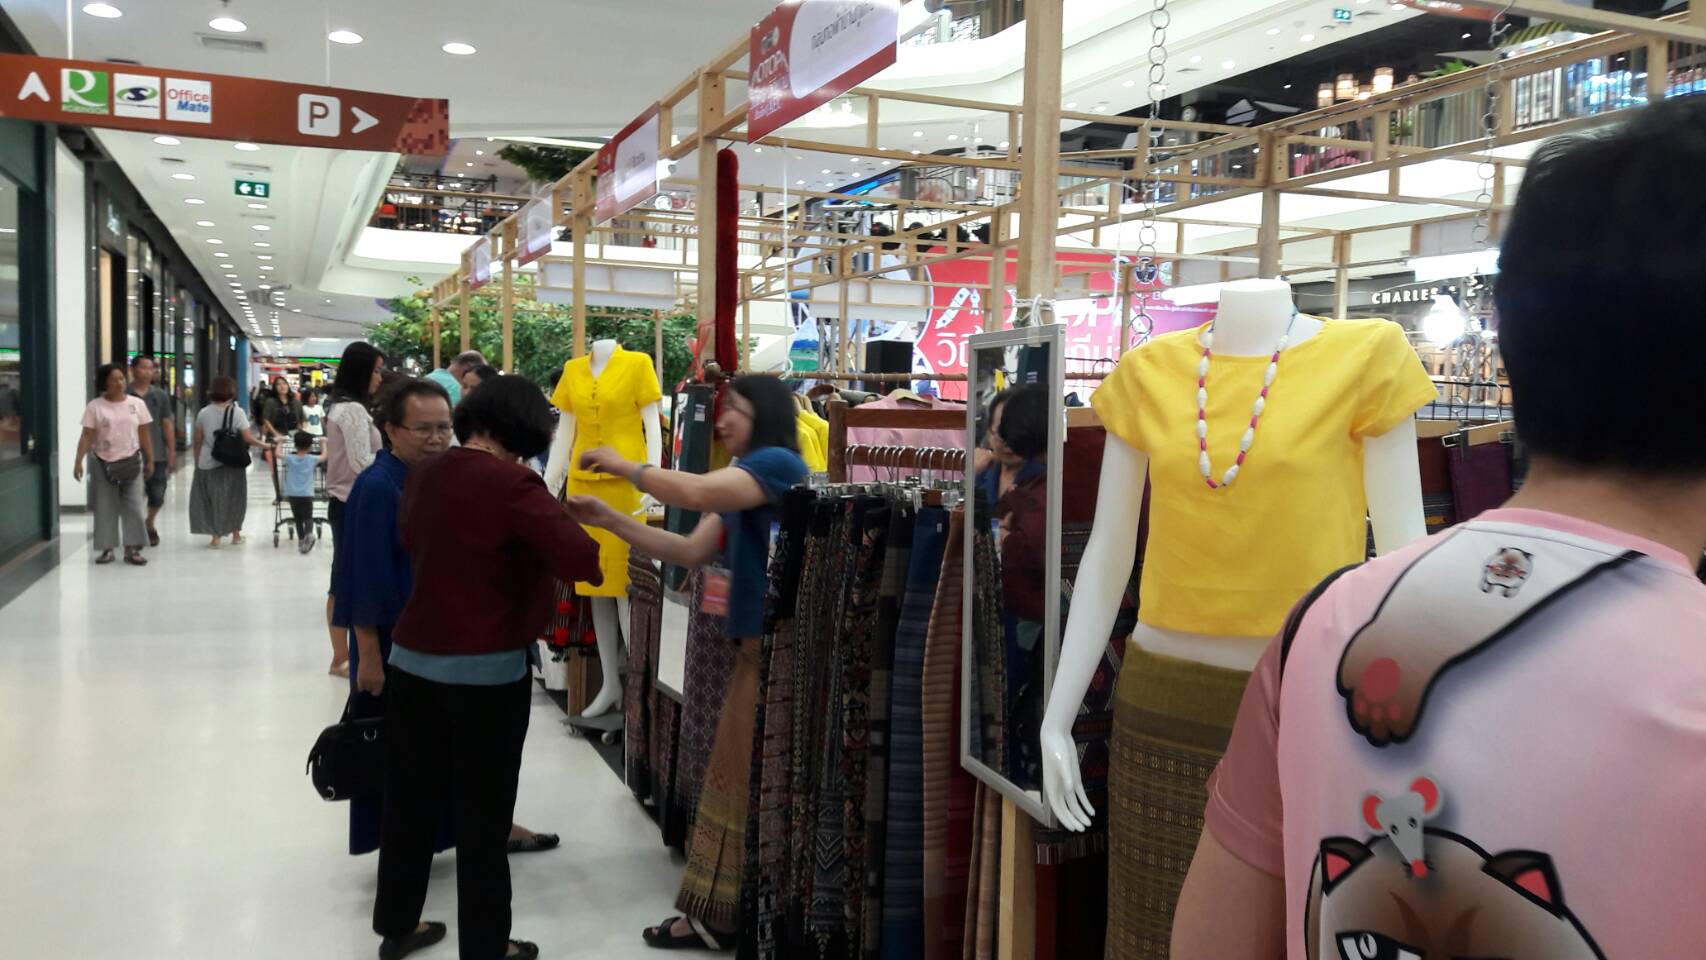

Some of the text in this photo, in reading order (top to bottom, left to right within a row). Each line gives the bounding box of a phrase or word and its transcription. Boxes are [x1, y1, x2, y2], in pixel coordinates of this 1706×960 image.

[167, 88, 209, 103] Office
[177, 100, 210, 113] Mate
[309, 101, 329, 128] P
[1371, 287, 1439, 304] CHARLES
